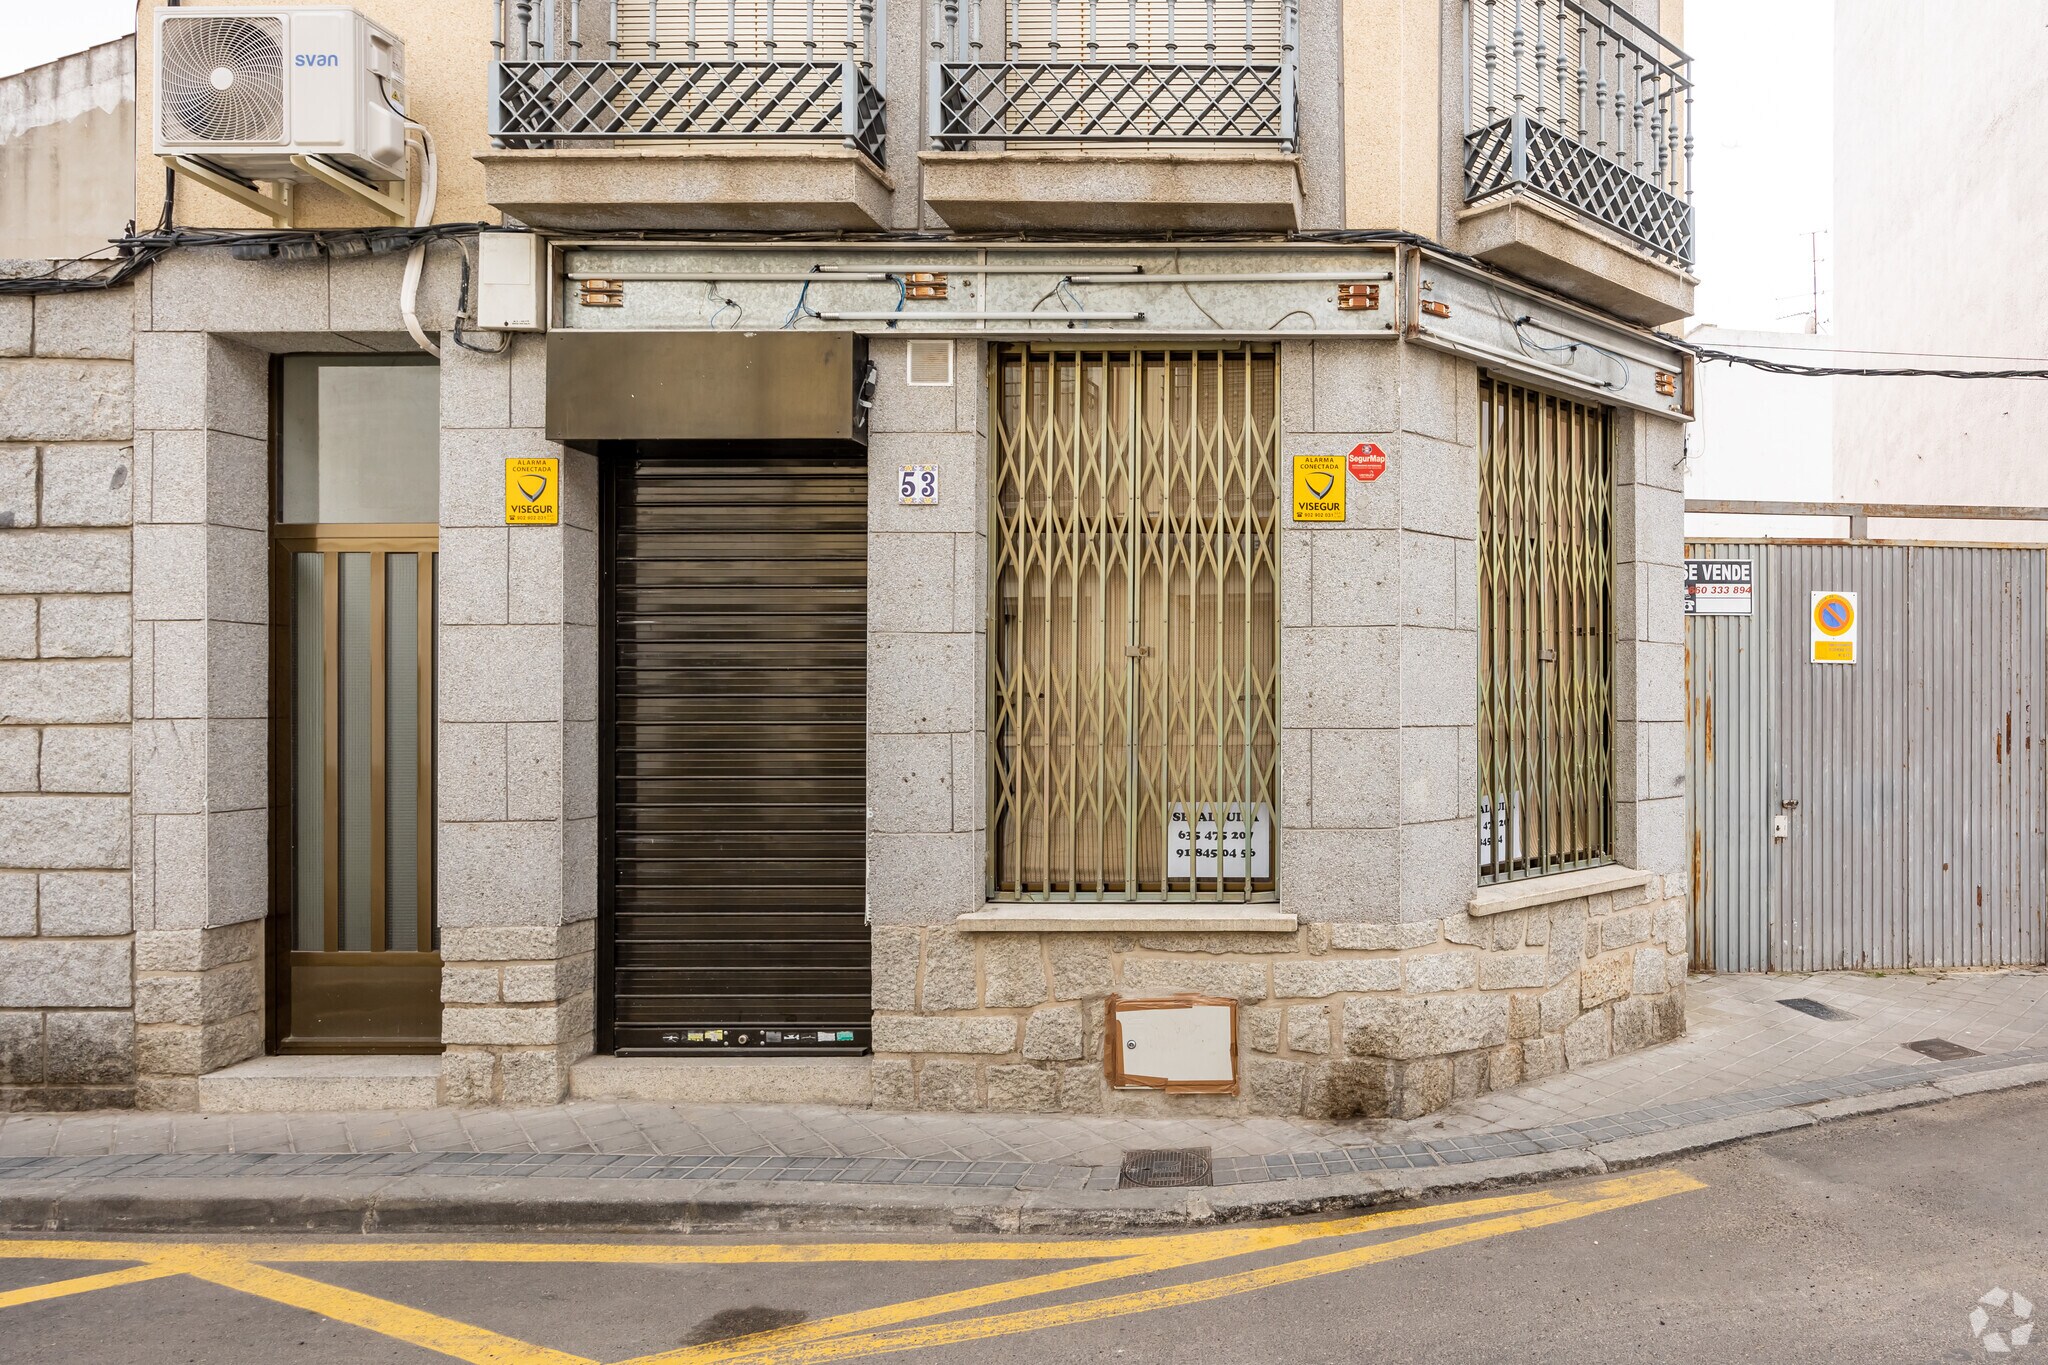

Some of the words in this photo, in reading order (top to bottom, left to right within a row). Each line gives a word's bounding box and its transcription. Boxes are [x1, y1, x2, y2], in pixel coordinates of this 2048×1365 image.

[295, 54, 338, 67] svan
[1349, 454, 1385, 464] SegurMap
[901, 471, 935, 497] 53
[511, 505, 553, 513] VISEGUR
[1298, 502, 1340, 511] VISEGUR
[1702, 564, 1750, 580] VENDE
[1711, 586, 1730, 595] 333
[1732, 586, 1752, 595] 894
[1176, 849, 1191, 858] 91
[1195, 848, 1218, 858] 845
